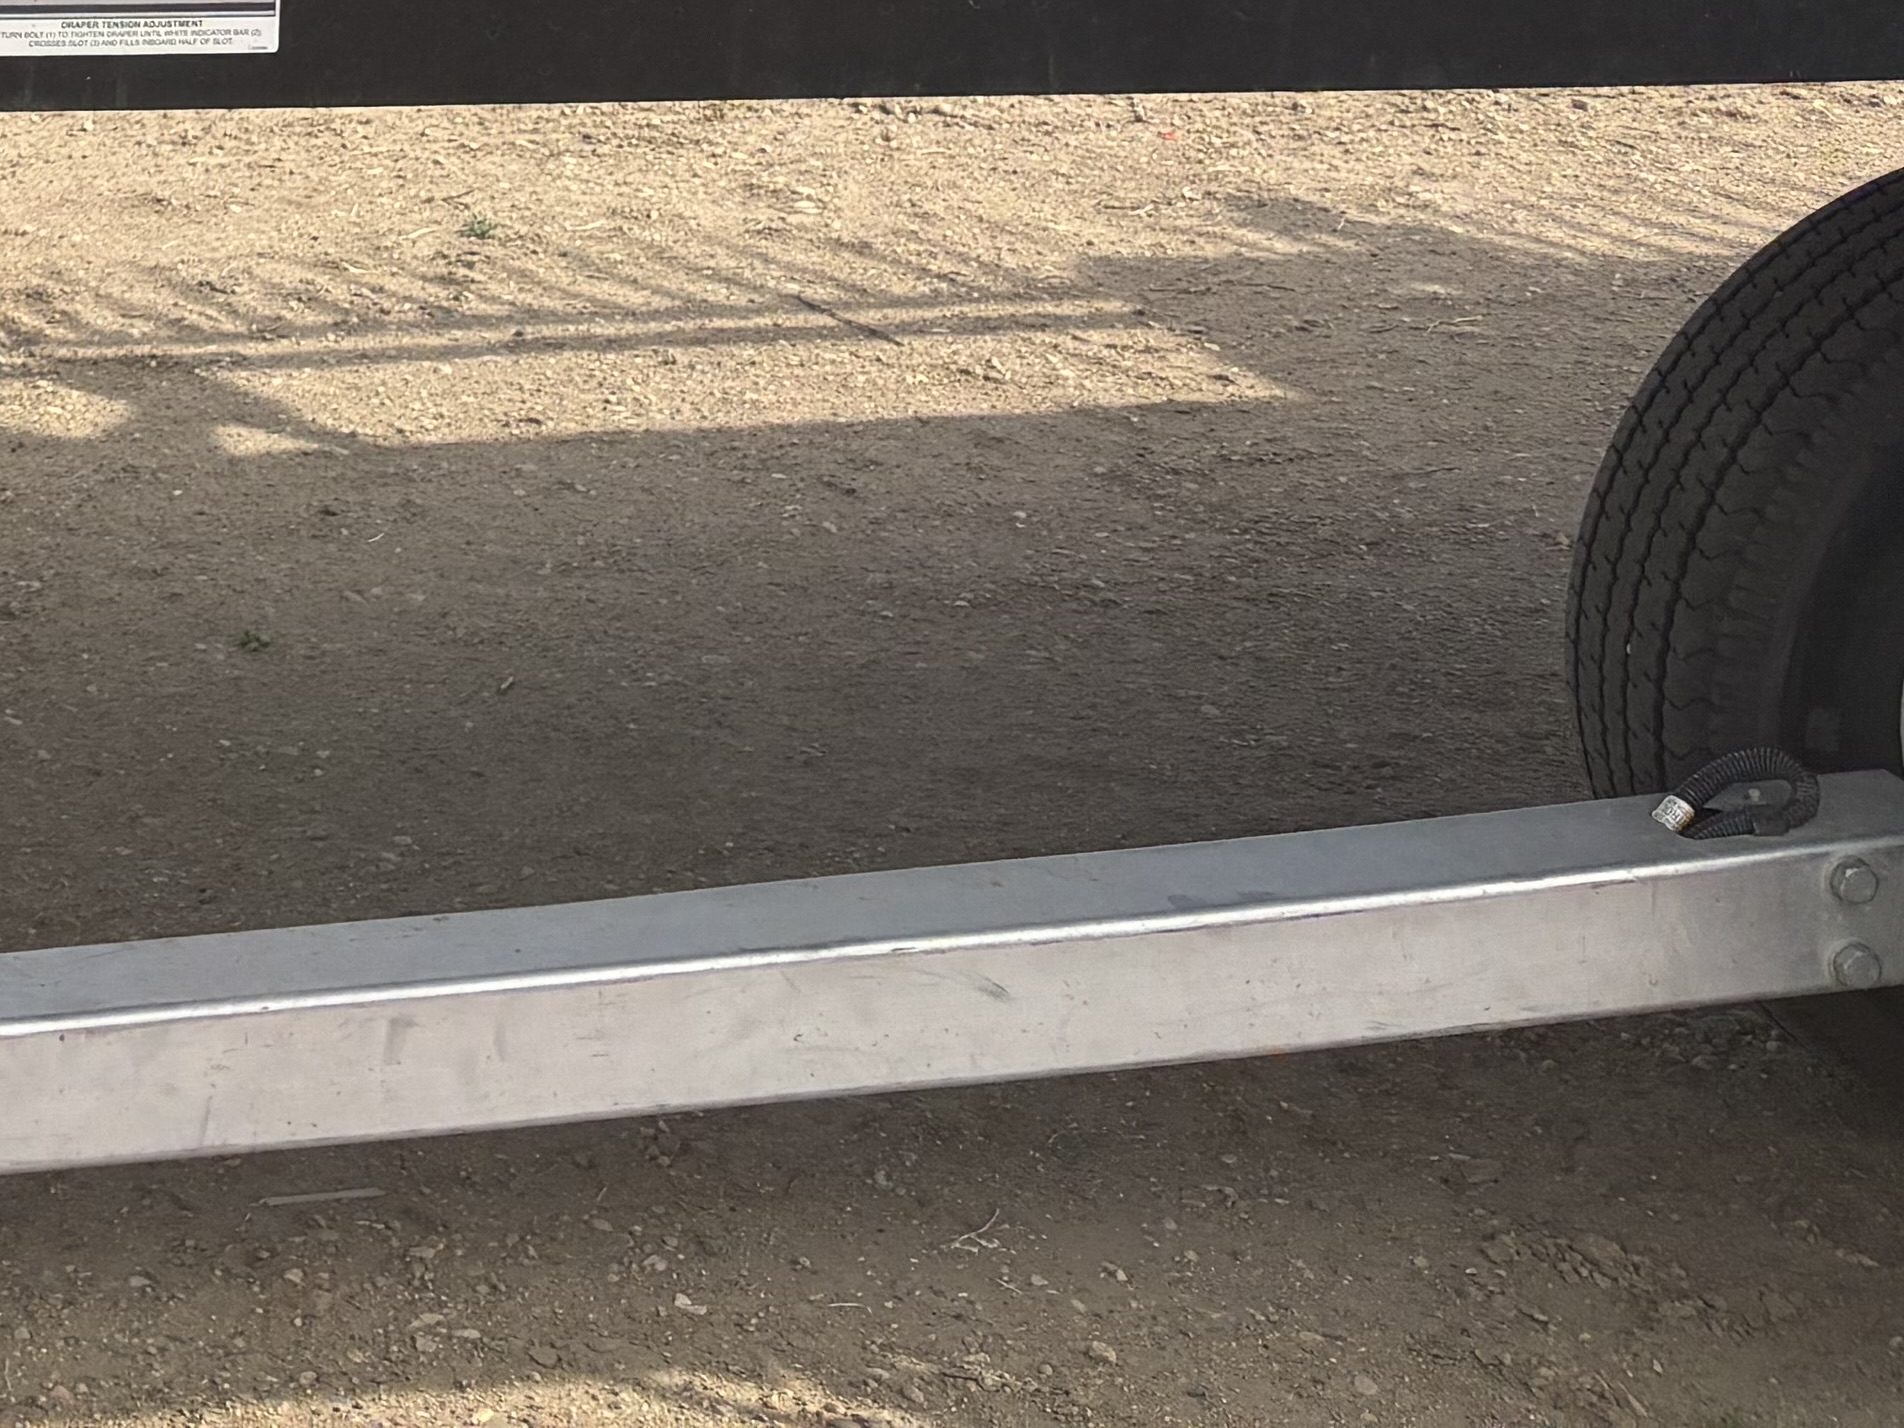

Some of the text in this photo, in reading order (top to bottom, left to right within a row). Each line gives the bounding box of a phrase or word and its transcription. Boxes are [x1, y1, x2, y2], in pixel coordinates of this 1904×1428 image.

[61, 19, 203, 29] DRAPER TENSION ADJUSTMENT
[1, 31, 23, 39] TURN
[142, 38, 177, 46] INBOARD
